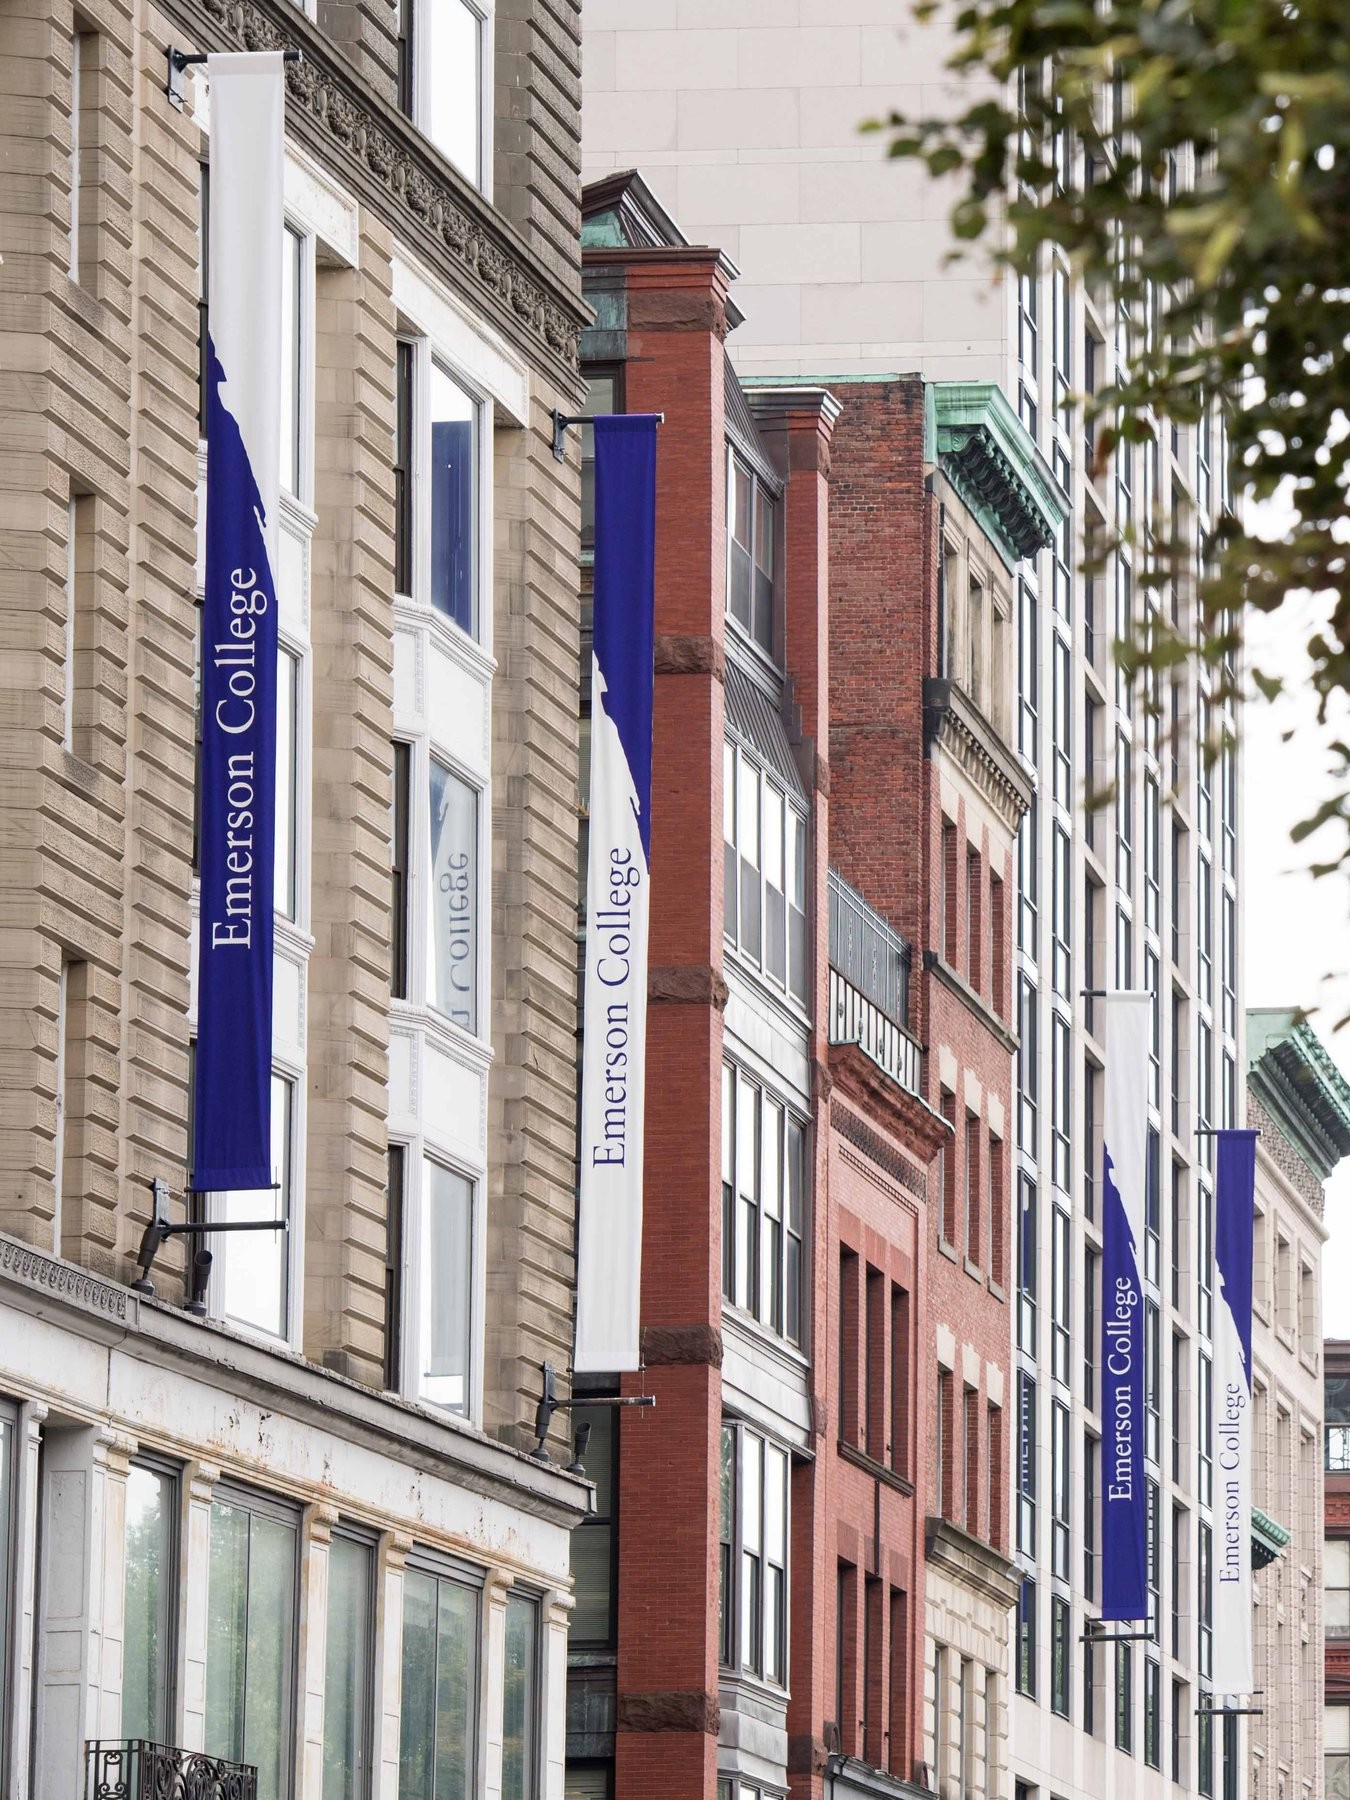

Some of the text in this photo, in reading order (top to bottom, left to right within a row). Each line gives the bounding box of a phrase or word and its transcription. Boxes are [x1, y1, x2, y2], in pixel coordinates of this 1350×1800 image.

[211, 567, 267, 950] Emerson College
[592, 847, 641, 1169] Emerson College
[1106, 1276, 1138, 1502] Emerson College
[1217, 1383, 1246, 1585] Emerson College
